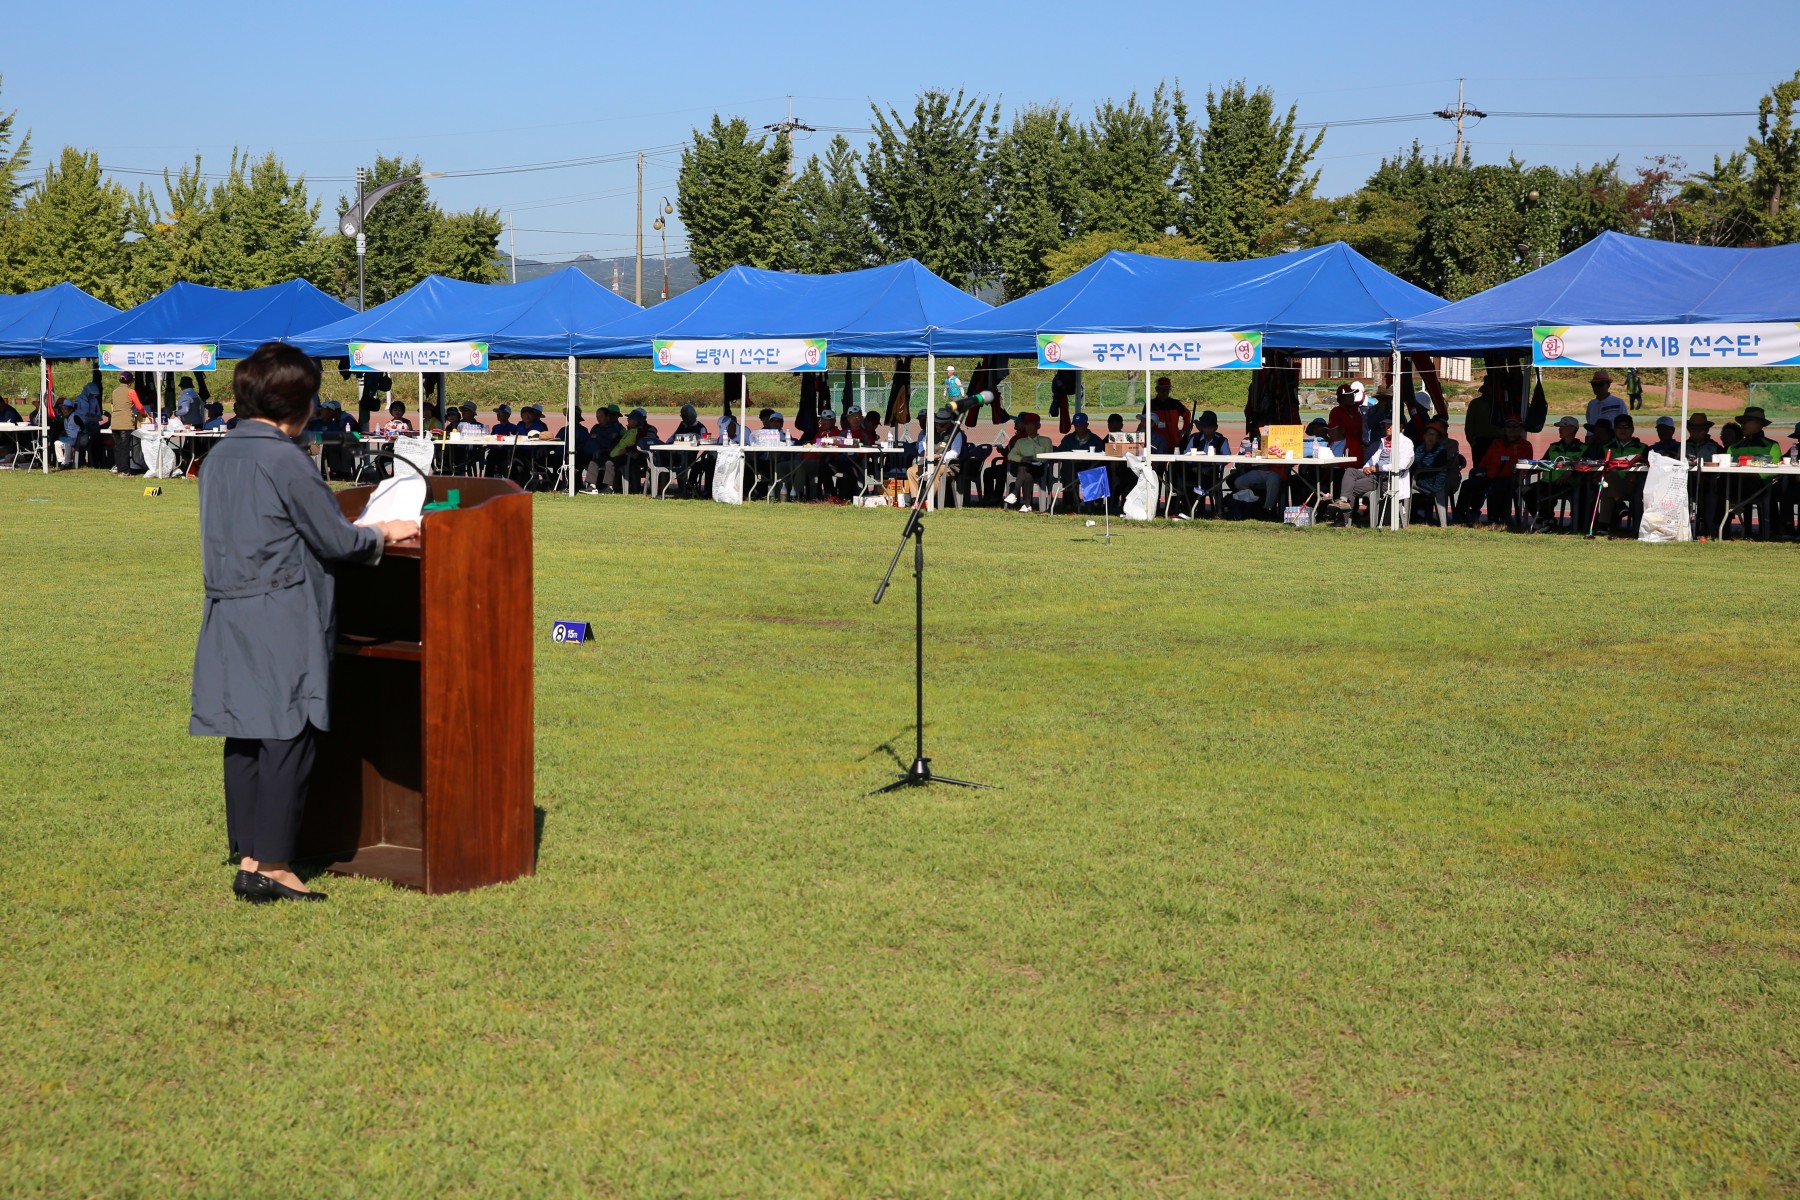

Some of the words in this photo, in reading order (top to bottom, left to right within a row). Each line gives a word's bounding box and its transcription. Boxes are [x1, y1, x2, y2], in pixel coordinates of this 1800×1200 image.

[1046, 344, 1059, 361] 환
[1092, 343, 1142, 362] 공주시
[1149, 342, 1202, 361] 선수단
[1238, 343, 1250, 360] 영
[1545, 338, 1561, 358] 환
[1600, 335, 1680, 357] 천안시B
[1690, 335, 1761, 357] 선수단
[127, 351, 154, 365] 금산군
[157, 351, 184, 365] 선수단
[382, 350, 414, 365] 서산시
[417, 350, 450, 365] 선수단
[659, 349, 669, 364] 환
[695, 348, 735, 365] 보령시
[739, 348, 780, 365] 선수단
[807, 349, 817, 363] 영
[555, 626, 565, 642] 8
[567, 629, 578, 639] 15m
